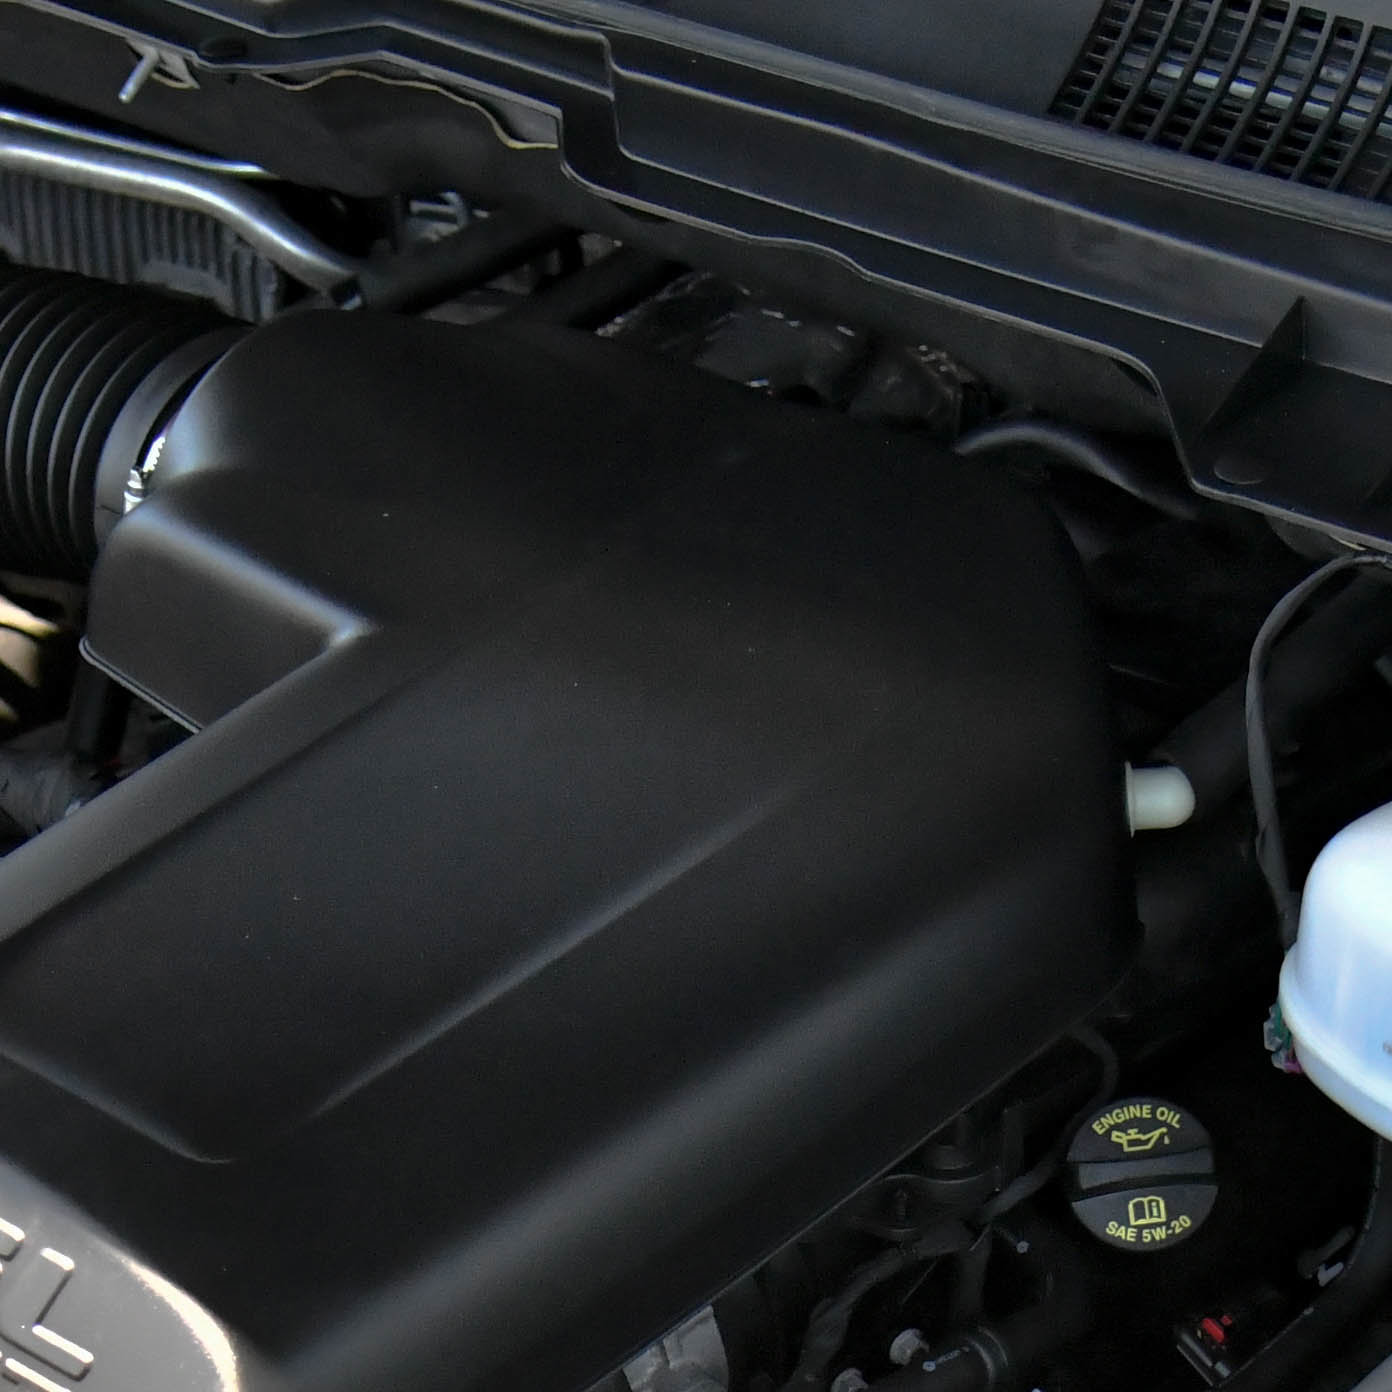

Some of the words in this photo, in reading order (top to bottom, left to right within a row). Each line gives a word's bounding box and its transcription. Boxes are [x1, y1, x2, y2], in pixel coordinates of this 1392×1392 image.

[1091, 1105, 1152, 1135] ENGINE
[1156, 1106, 1183, 1128] OIL
[1105, 1221, 1137, 1242] SAE
[1142, 1216, 1192, 1242] 5W-20
